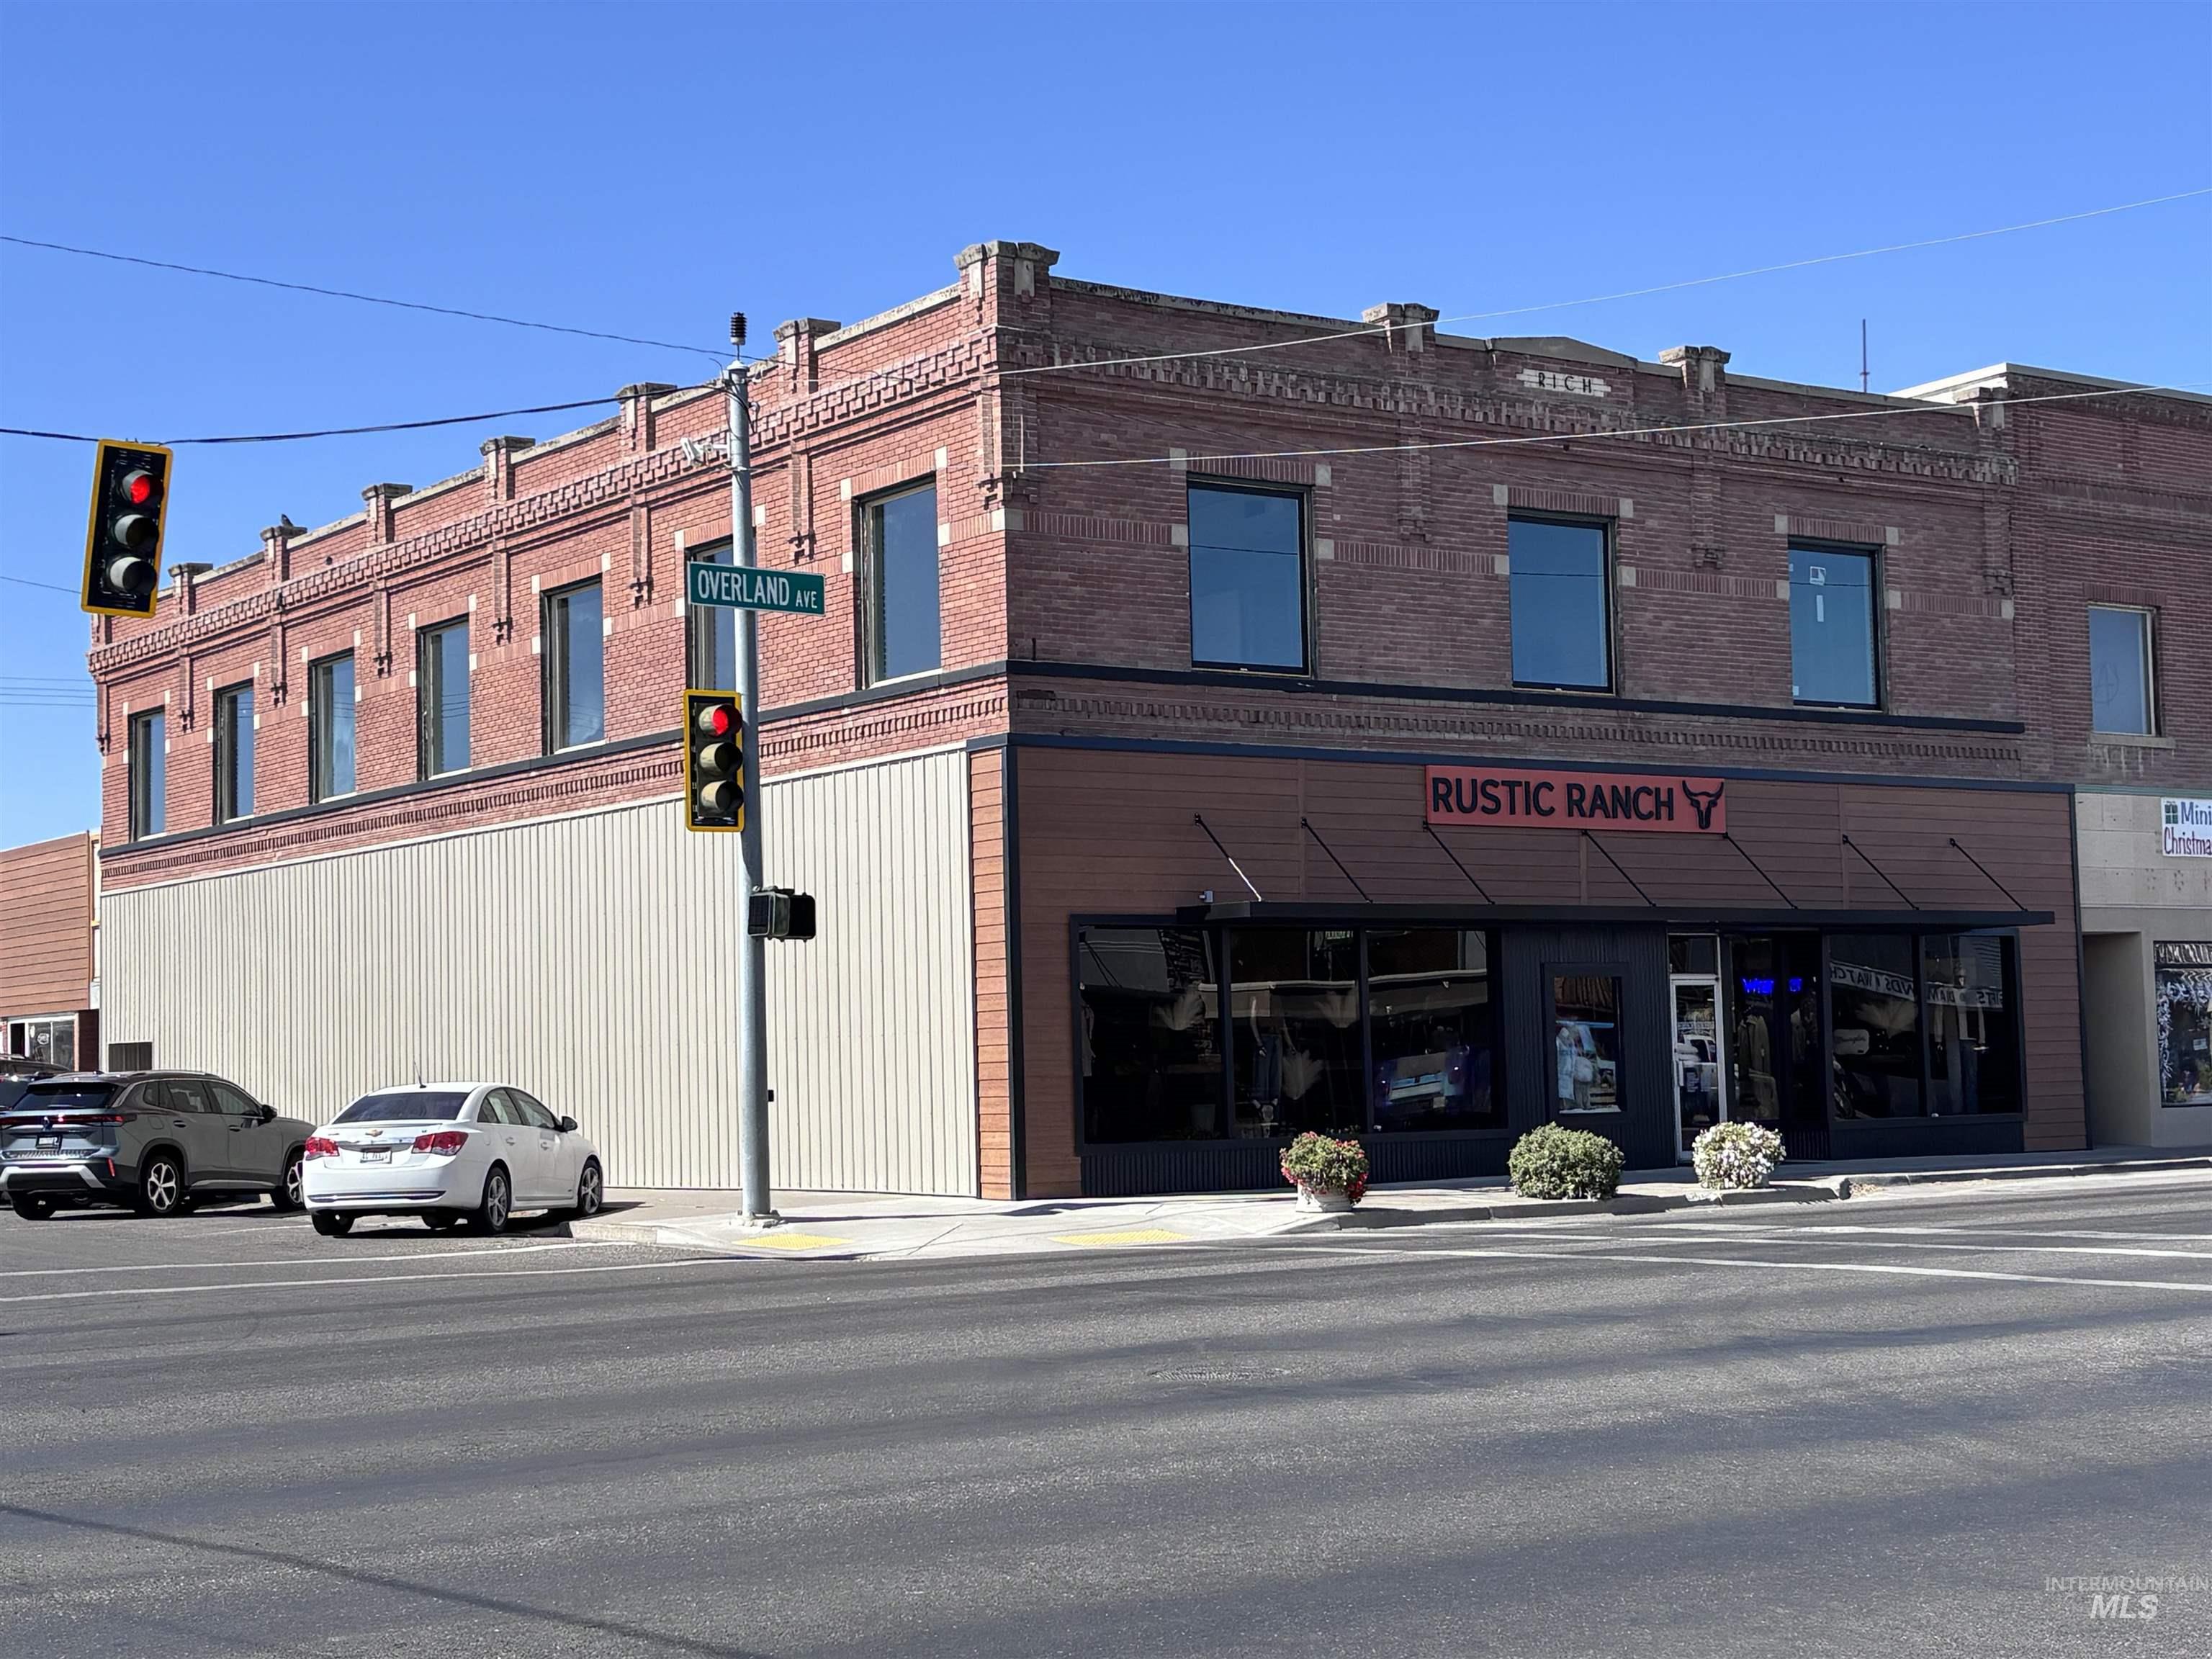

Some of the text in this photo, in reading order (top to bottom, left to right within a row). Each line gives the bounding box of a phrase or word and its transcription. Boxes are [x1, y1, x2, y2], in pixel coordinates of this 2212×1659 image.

[1538, 372, 1592, 394] RICH
[698, 570, 817, 608] OVERLAND AVE
[1431, 776, 1674, 820] RUSTIC RANCH
[2181, 801, 2212, 825] Mini
